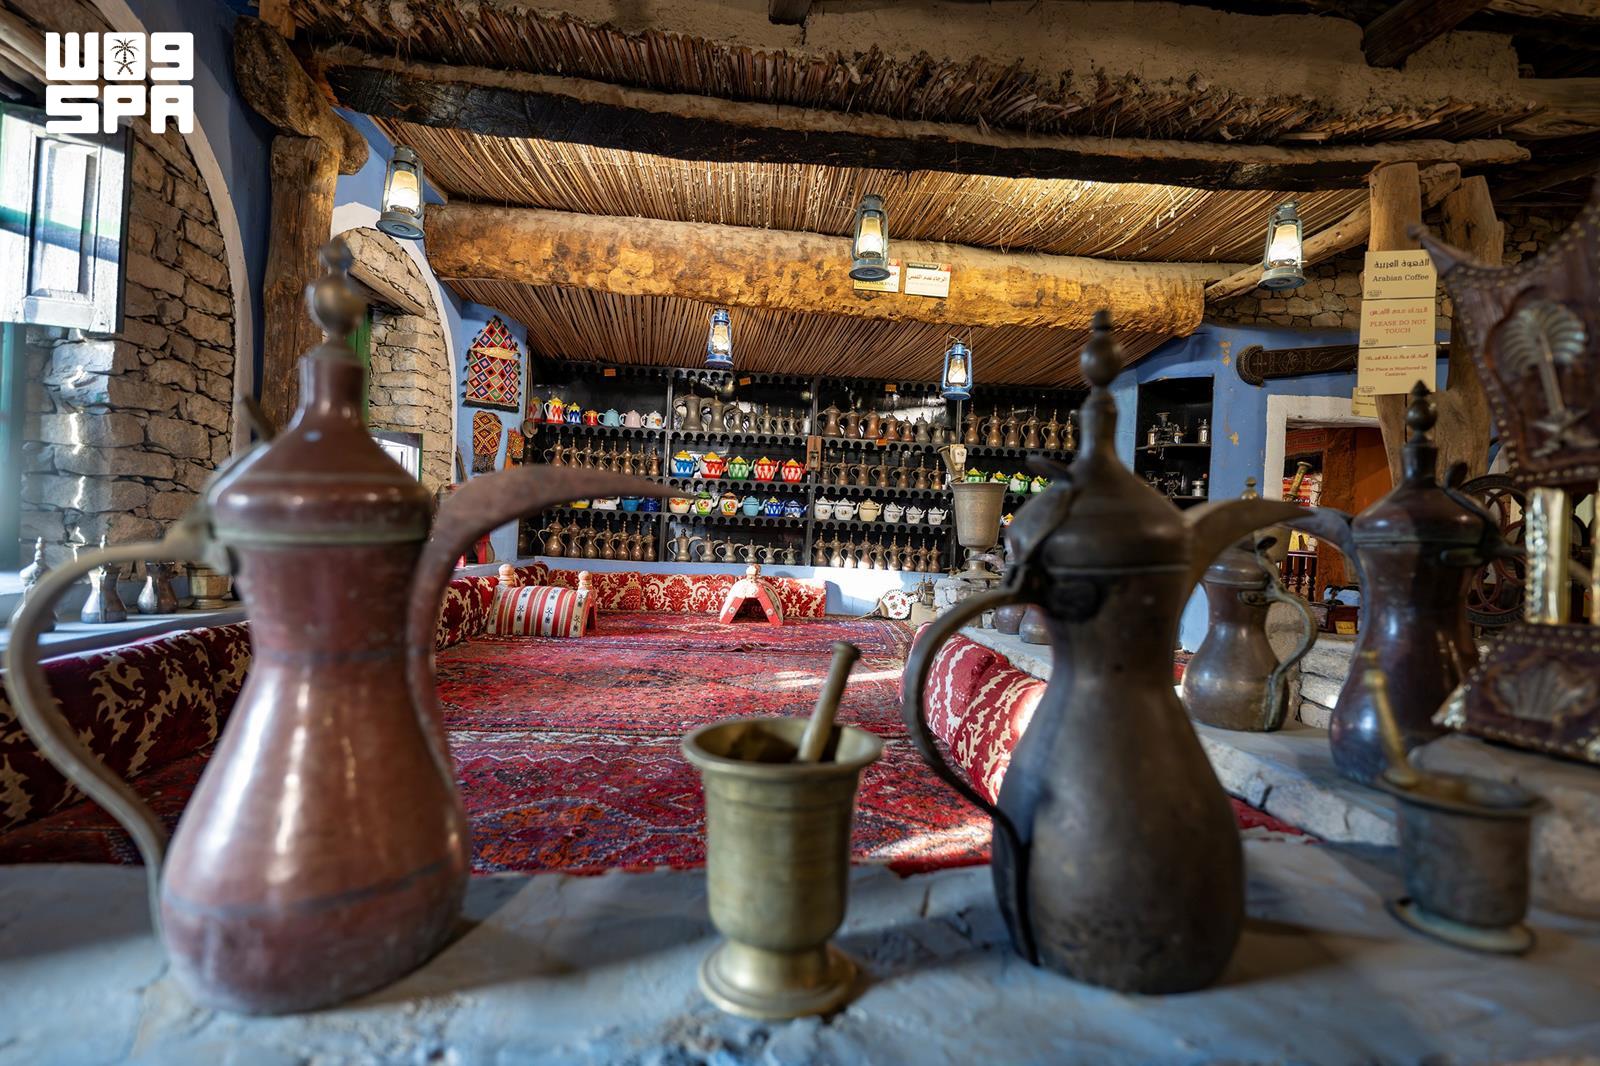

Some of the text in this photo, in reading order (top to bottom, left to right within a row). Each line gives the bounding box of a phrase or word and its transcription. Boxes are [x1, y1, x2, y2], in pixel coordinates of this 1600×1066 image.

[1375, 258, 1430, 269] القهوة العربية
[1372, 273, 1430, 282] Arabian Coffee
[1369, 319, 1397, 328] PLEASE
[1384, 327, 1411, 335] TOUCH
